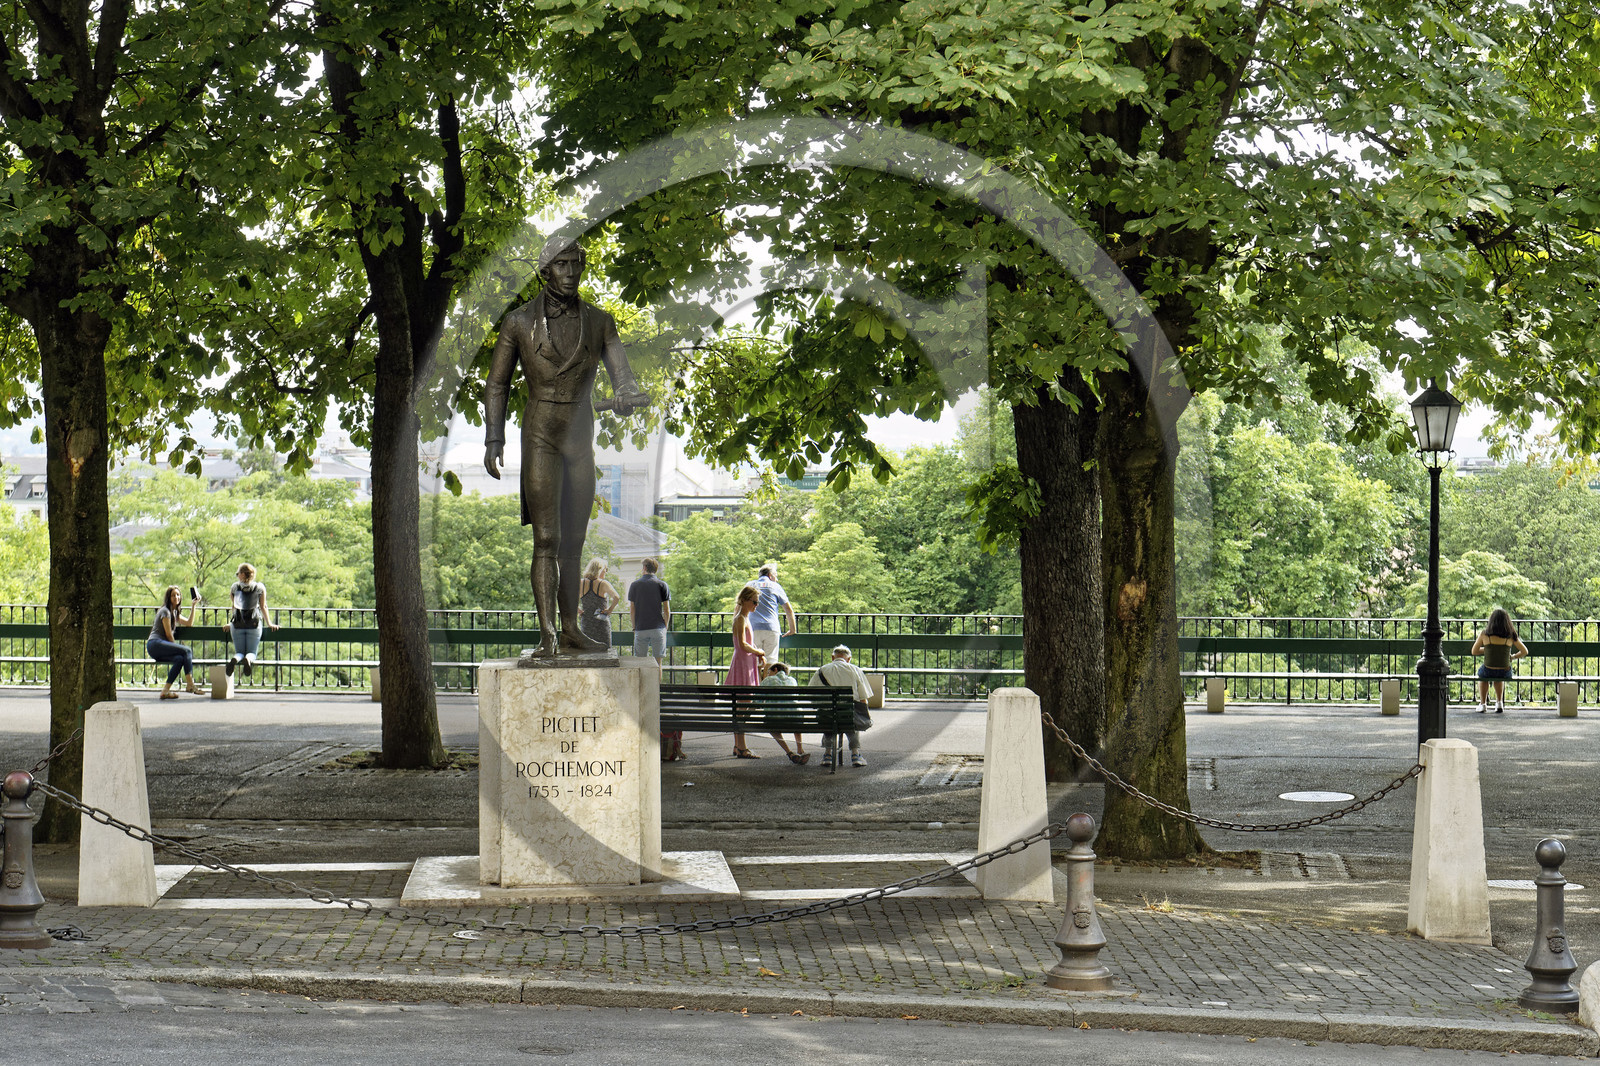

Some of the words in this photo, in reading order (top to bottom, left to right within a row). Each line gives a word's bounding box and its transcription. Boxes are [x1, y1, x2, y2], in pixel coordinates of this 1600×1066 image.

[541, 716, 600, 734] PICTET
[560, 740, 580, 754] DE
[516, 760, 626, 778] ROCHEMONT
[528, 785, 560, 799] 1755
[580, 784, 613, 798] 1824
